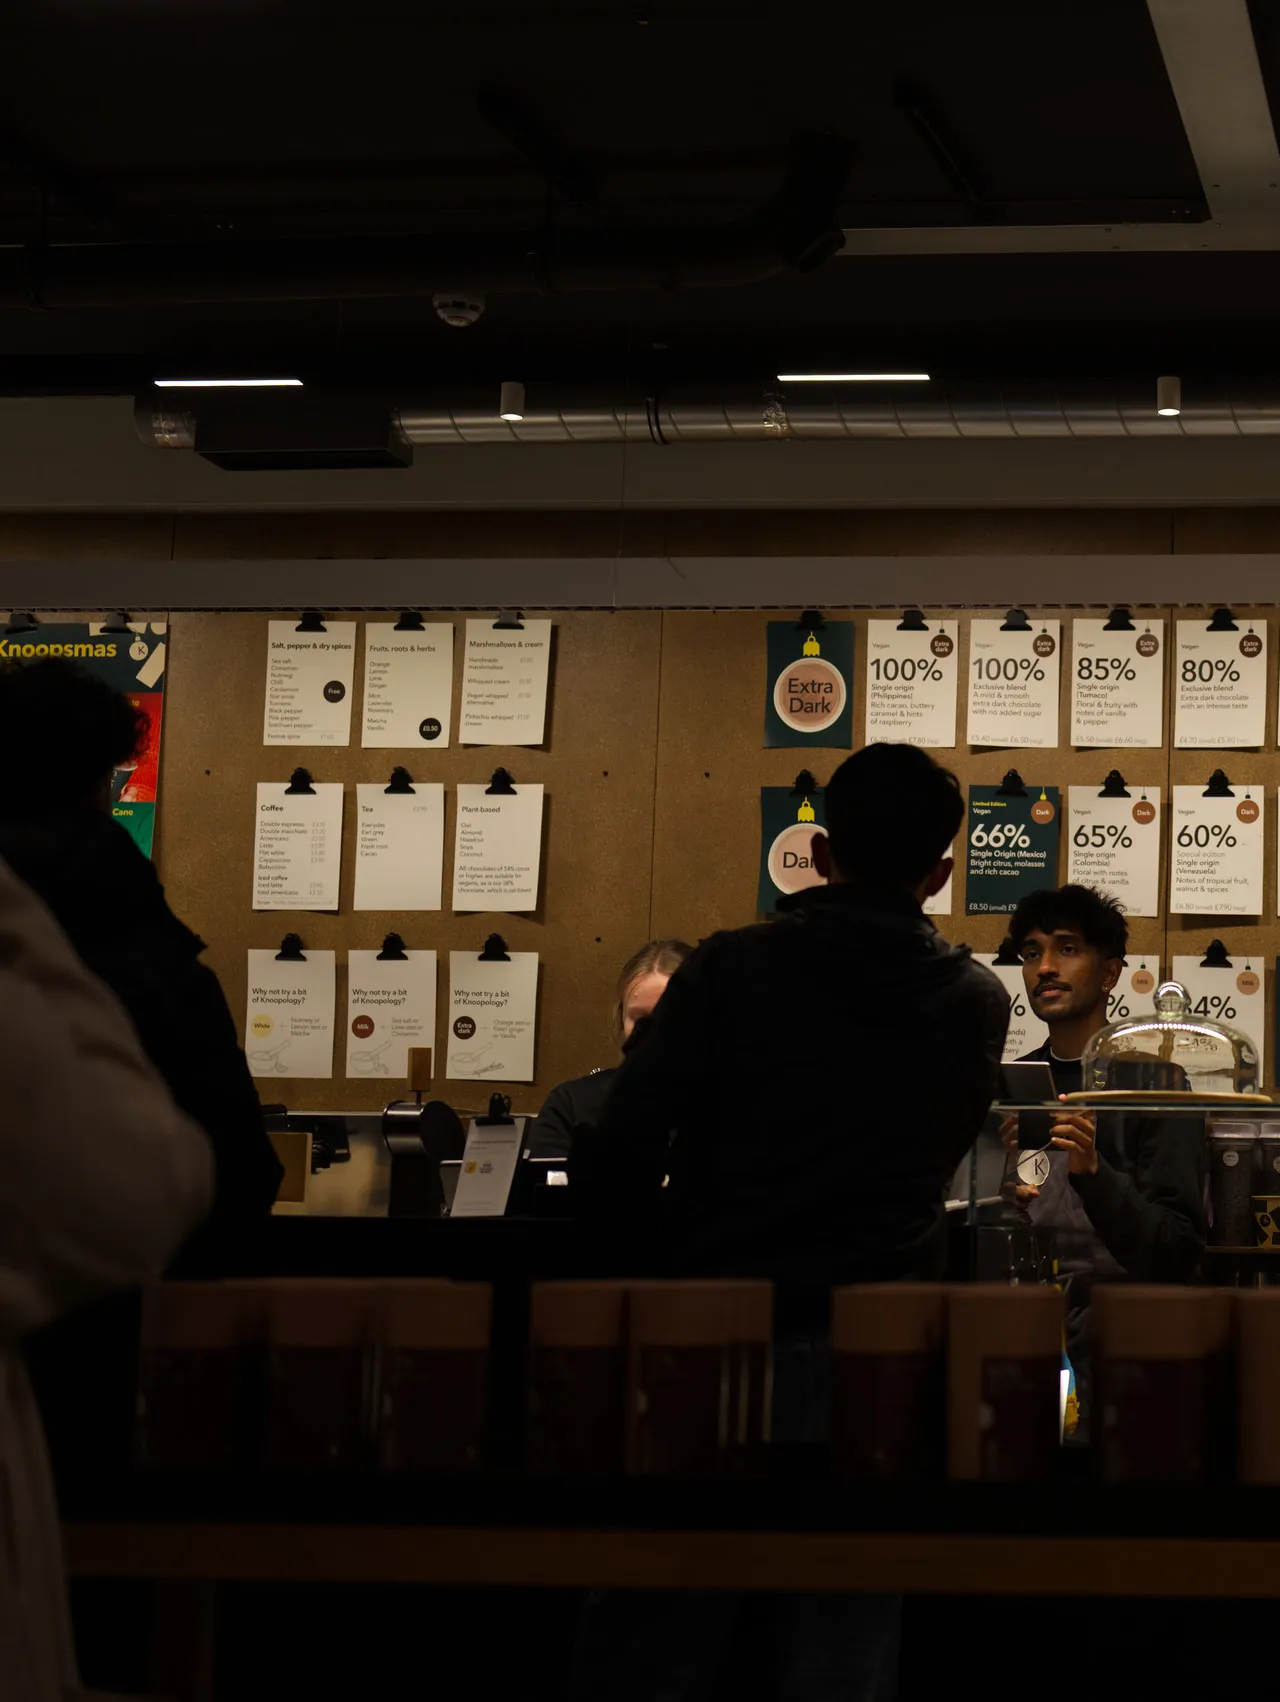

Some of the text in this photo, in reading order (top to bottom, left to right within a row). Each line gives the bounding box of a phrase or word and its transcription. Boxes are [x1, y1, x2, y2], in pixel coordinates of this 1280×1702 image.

[138, 646, 145, 655] K
[870, 658, 943, 682] 100%
[973, 658, 1045, 681] 100%
[1078, 658, 1136, 681] 85%
[1182, 659, 1240, 682] 80%
[788, 679, 833, 693] Extra
[872, 684, 914, 692] Single origin
[1077, 683, 1097, 691] Single
[790, 698, 831, 713] Dark
[911, 703, 935, 711] buttery
[112, 808, 133, 816] Cane
[971, 824, 1031, 848] 66%
[1074, 825, 1132, 848] 65%
[1177, 825, 1237, 848] 60%
[971, 850, 1046, 859] Single Origin (Mexico)
[1074, 851, 1116, 859] Single origin
[971, 859, 991, 868] Bright
[993, 860, 1013, 868] citrus,
[252, 988, 267, 996] Why
[1186, 996, 1236, 1019] 4%
[1035, 1158, 1045, 1176] K
